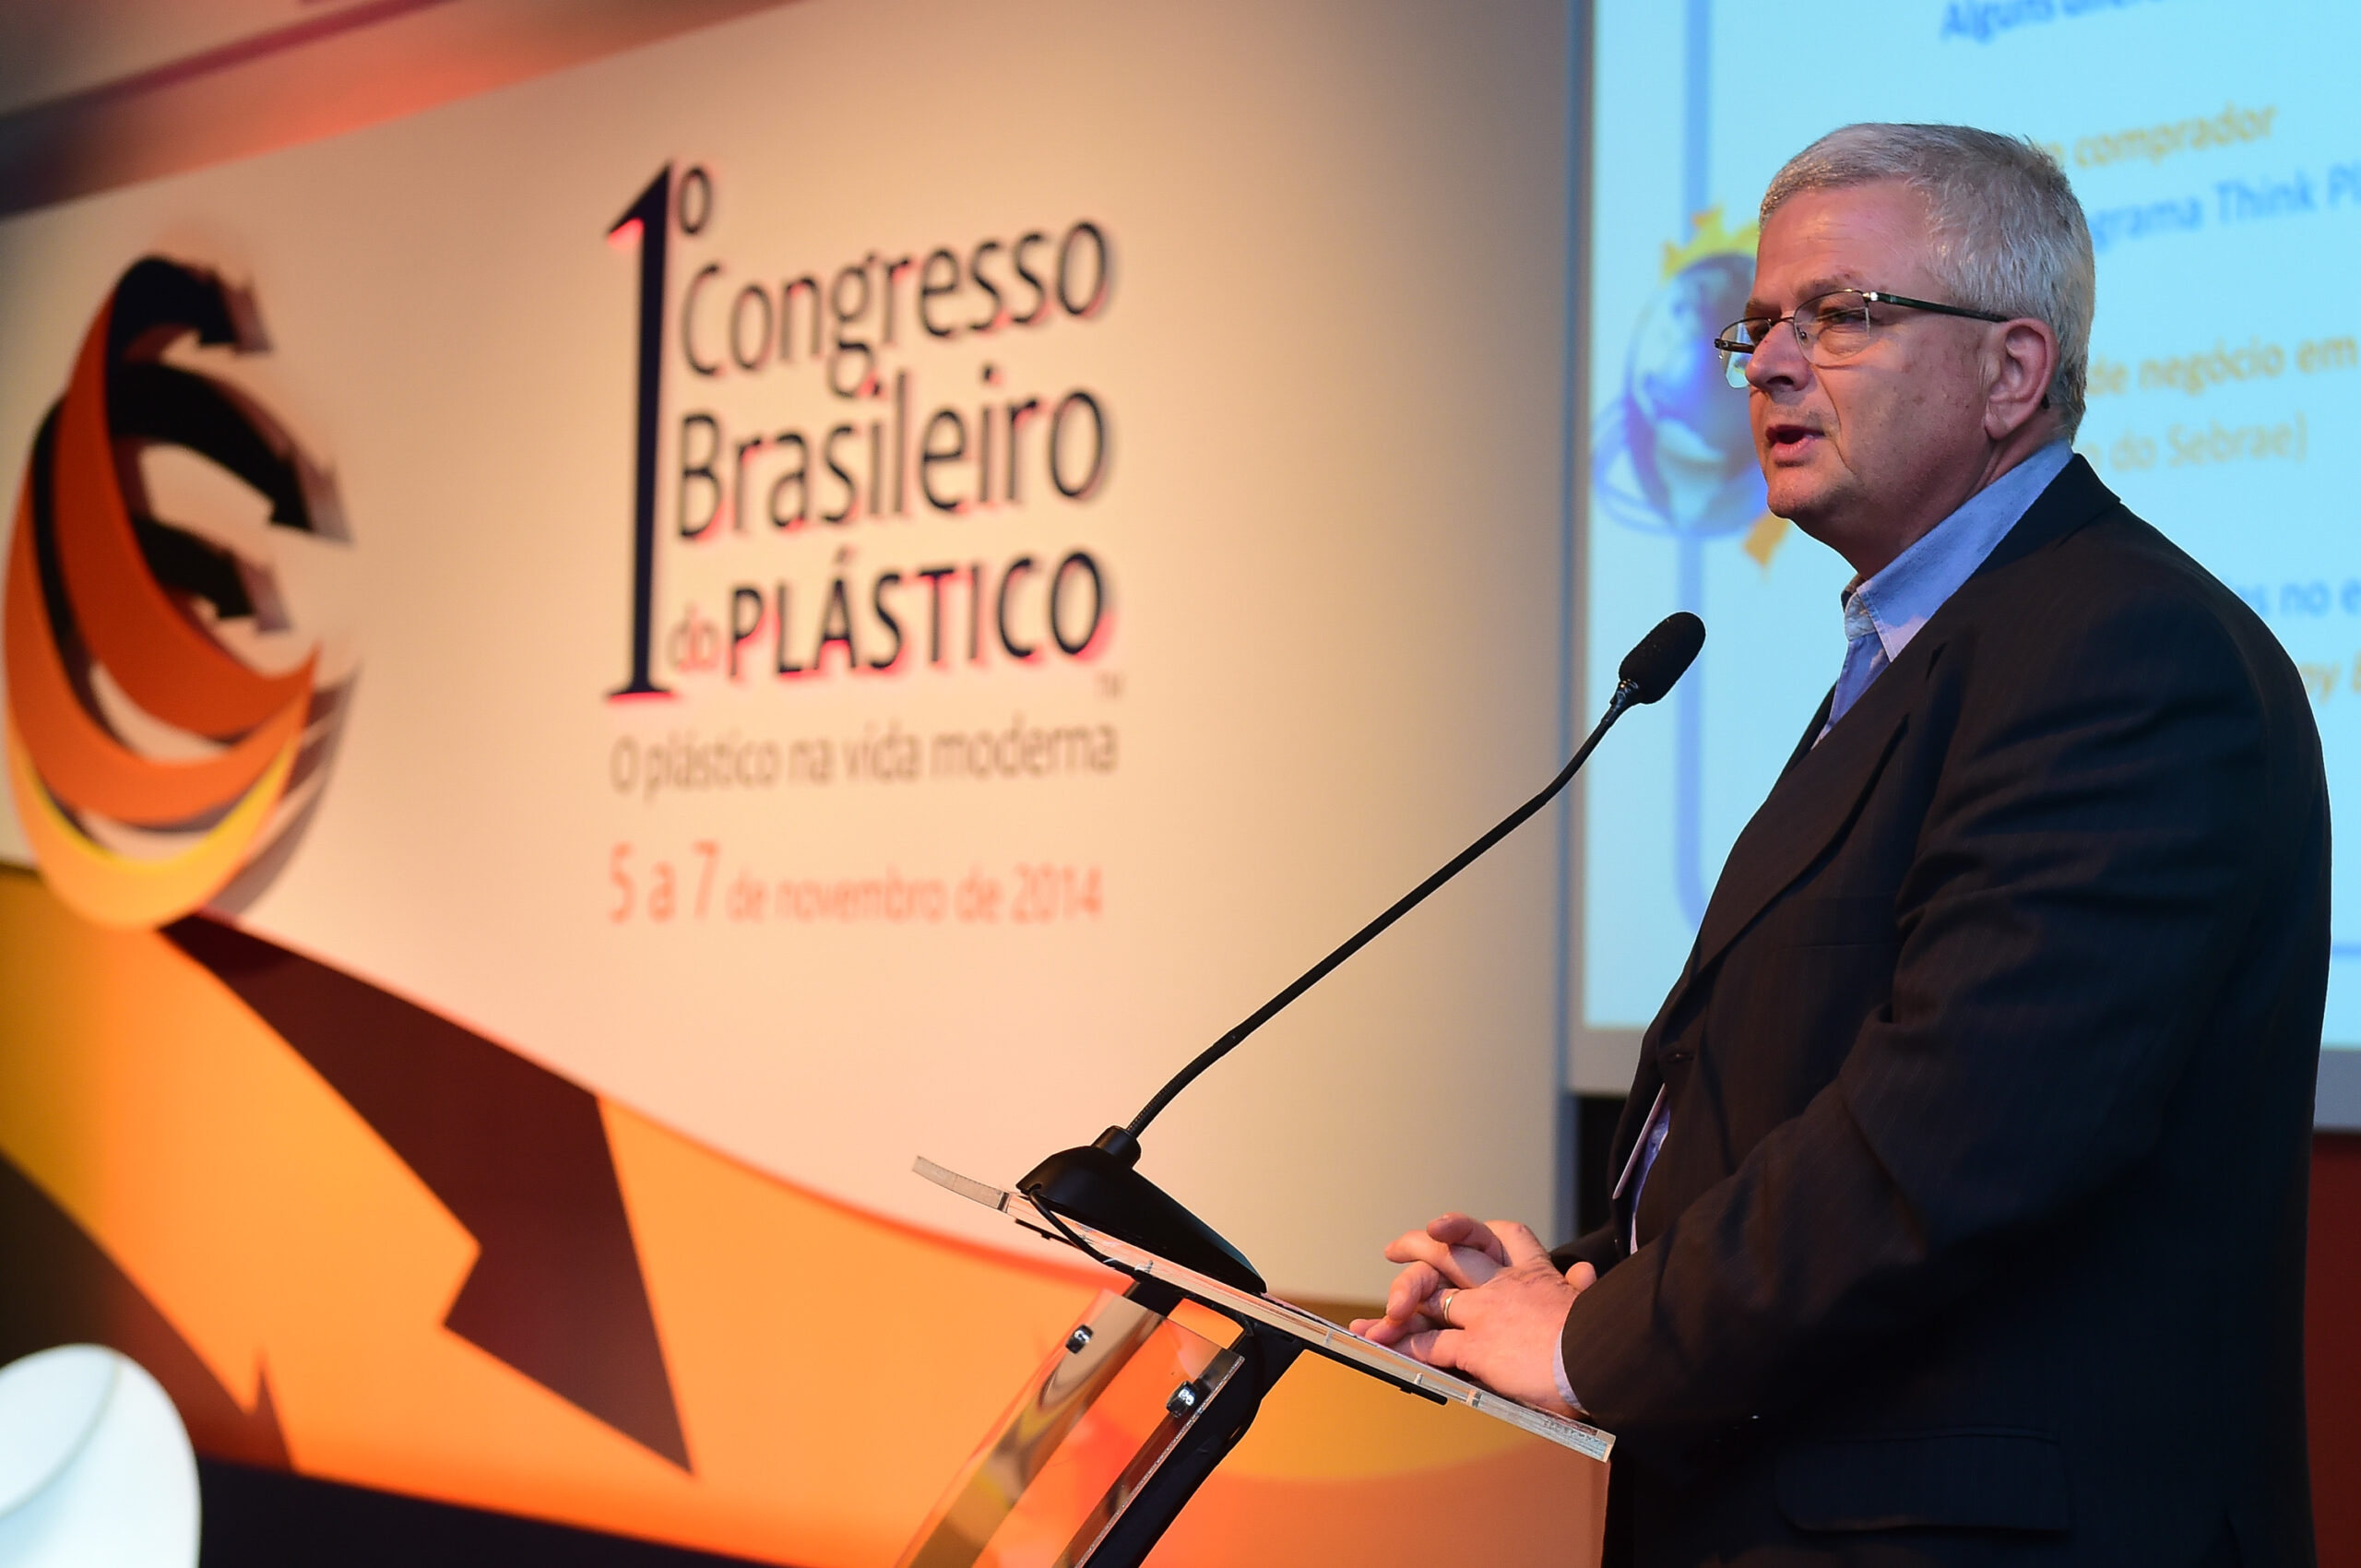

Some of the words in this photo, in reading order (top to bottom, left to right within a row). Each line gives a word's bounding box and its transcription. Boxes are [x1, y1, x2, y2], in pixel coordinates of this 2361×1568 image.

[2074, 101, 2277, 168] comprador
[2214, 163, 2318, 225] Think
[681, 220, 1111, 400] Congresso
[2139, 336, 2285, 397] negócio
[2296, 335, 2358, 374] em
[678, 362, 1111, 542] Brasileiro
[2110, 427, 2157, 472] do
[666, 600, 722, 673] do
[728, 546, 1114, 683] PLÁSTICO
[2279, 579, 2333, 618] no
[610, 734, 639, 795] O
[643, 727, 782, 804] plástico
[788, 737, 835, 787] na
[841, 718, 922, 784] vida
[927, 710, 1121, 781] moderna
[608, 840, 637, 924] 5
[647, 860, 678, 923] a
[691, 839, 721, 921] 7
[726, 865, 769, 924] de
[776, 862, 950, 924] novembro
[954, 862, 1003, 924] de
[1010, 861, 1105, 925] 2014
